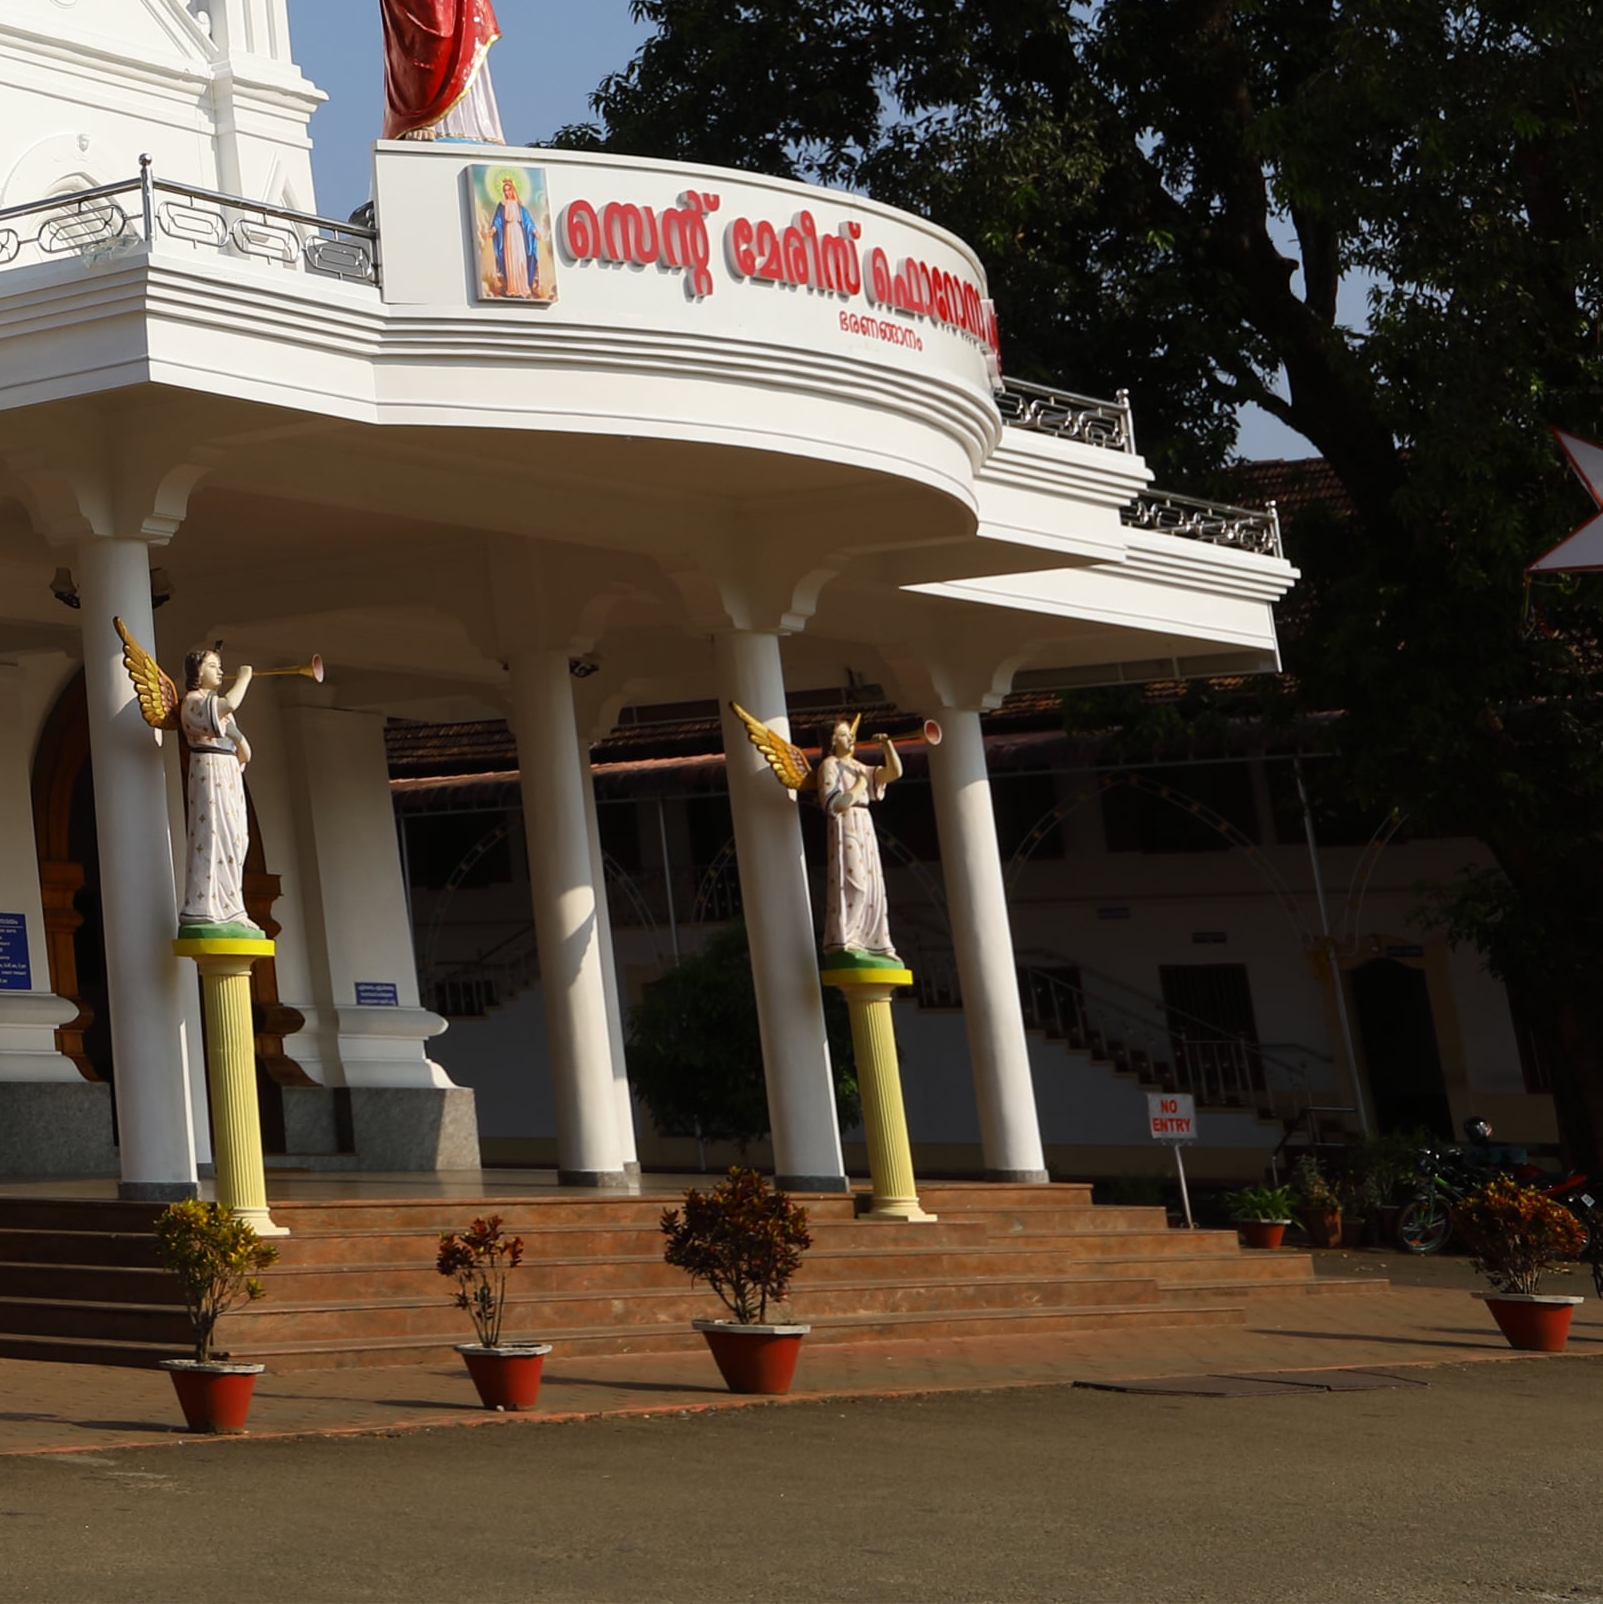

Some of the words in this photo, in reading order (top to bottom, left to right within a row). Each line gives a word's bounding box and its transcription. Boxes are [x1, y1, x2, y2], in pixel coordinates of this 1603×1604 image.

[727, 210, 862, 296] മേരീസ്
[839, 310, 924, 353] ഭരണങ്ങാനം
[1160, 1099, 1178, 1114] NO
[1152, 1117, 1191, 1133] ENTRY
